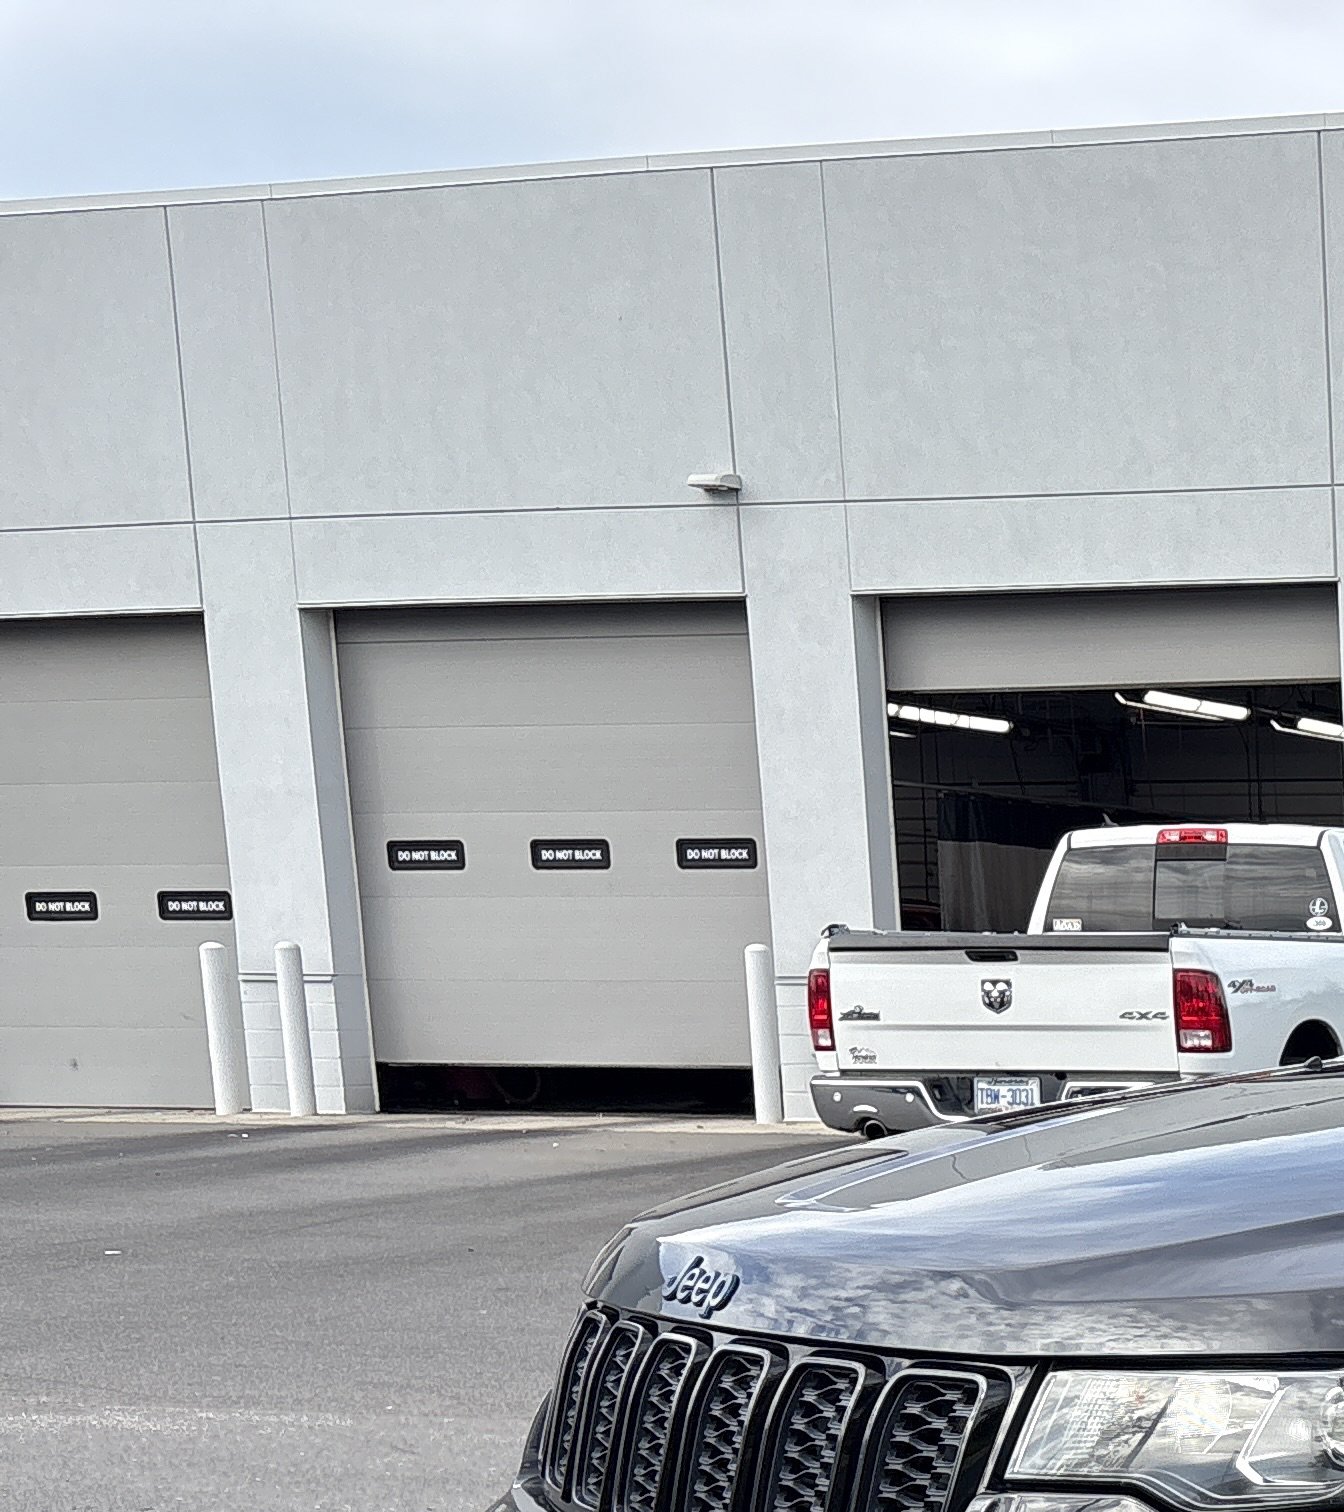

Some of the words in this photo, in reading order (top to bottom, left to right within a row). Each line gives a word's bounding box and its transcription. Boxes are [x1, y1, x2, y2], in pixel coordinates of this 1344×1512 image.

[398, 850, 410, 860] DO
[412, 850, 429, 860] NOT
[430, 850, 457, 860] BLOCK
[541, 850, 554, 860] DO
[556, 850, 573, 860] NOT
[575, 850, 602, 860] BLOCK
[686, 849, 700, 859] DO
[701, 849, 719, 859] NOT
[720, 849, 749, 859] BLOCK
[35, 901, 47, 911] DO
[49, 901, 64, 911] NOT
[65, 901, 90, 911] BLOCK
[168, 901, 180, 911] DO
[182, 901, 197, 911] NOT
[199, 901, 225, 911] BLOCK
[662, 1255, 740, 1320] Jeep
